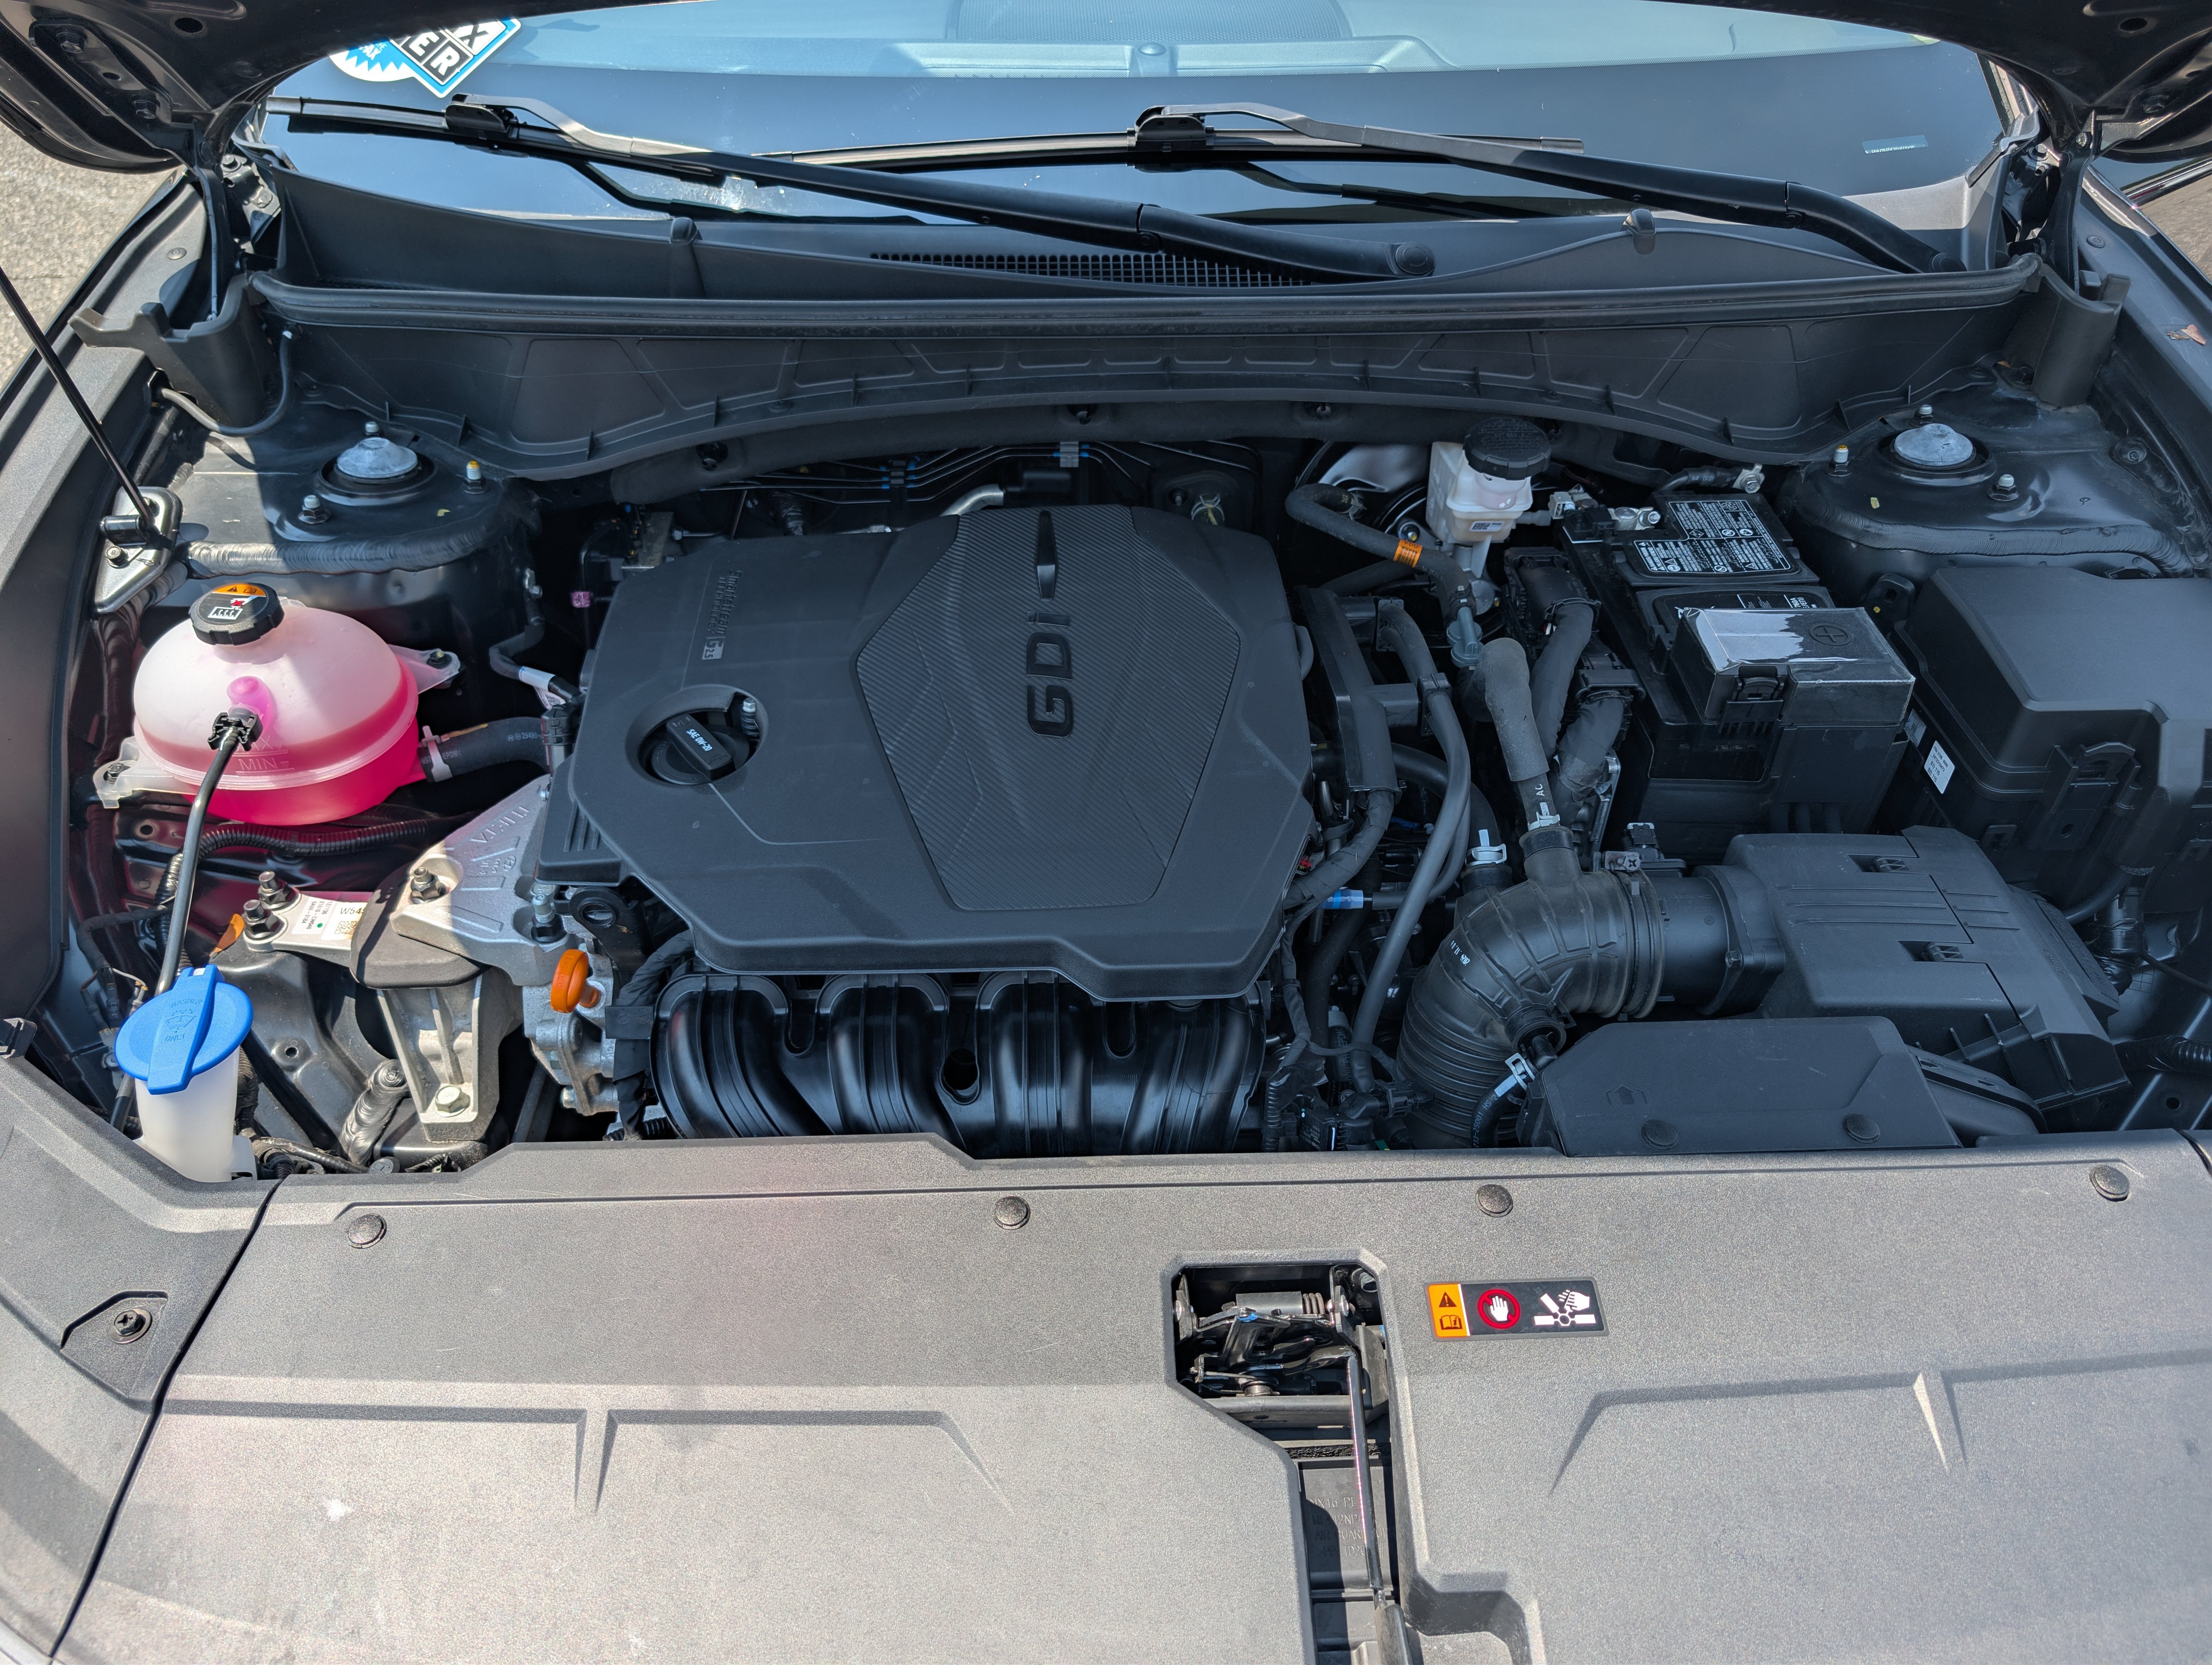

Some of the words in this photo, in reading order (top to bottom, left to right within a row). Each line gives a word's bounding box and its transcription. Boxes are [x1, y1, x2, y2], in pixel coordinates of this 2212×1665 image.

[707, 577, 727, 634] TECHNOLOGY
[718, 570, 742, 635] Smartstream
[685, 728, 700, 739] SAE
[694, 737, 713, 751] 0W-20
[238, 757, 277, 772] MIN
[1534, 783, 1545, 797] AC
[169, 998, 202, 1009] WASHER
[165, 1033, 185, 1042] ONLY
[1315, 1529, 1330, 1541] AIR
